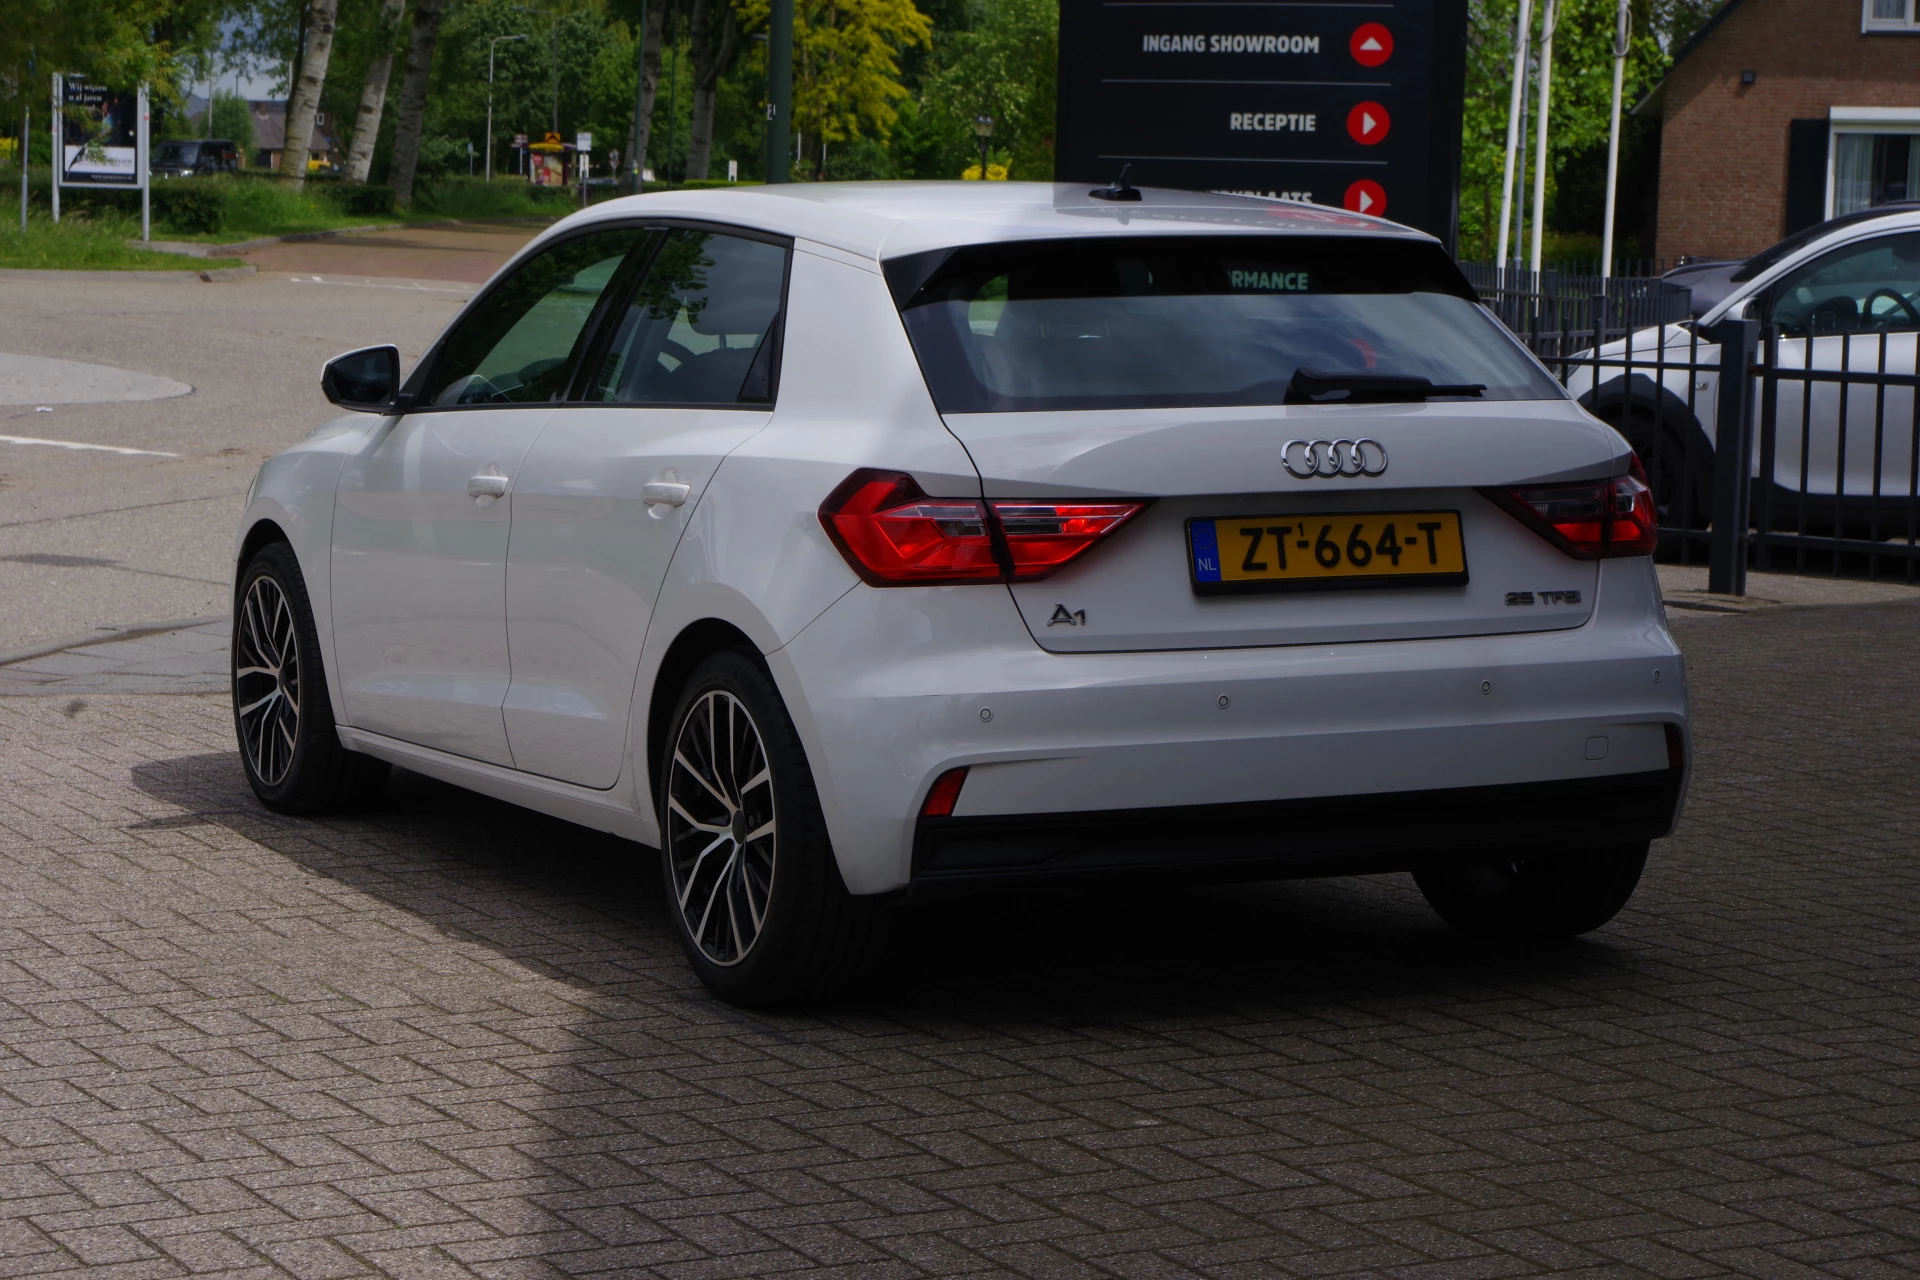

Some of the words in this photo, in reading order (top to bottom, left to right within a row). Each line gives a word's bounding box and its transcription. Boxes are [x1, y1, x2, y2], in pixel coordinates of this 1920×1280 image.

[1143, 34, 1206, 53] INGANG
[1210, 35, 1320, 54] SHOWROOM
[69, 83, 82, 92] Wij
[1230, 112, 1317, 132] RECEPTIE
[1227, 269, 1309, 291] RMANCE
[1198, 558, 1217, 572] NL
[1505, 592, 1535, 606] 25
[1047, 603, 1086, 627] A1
